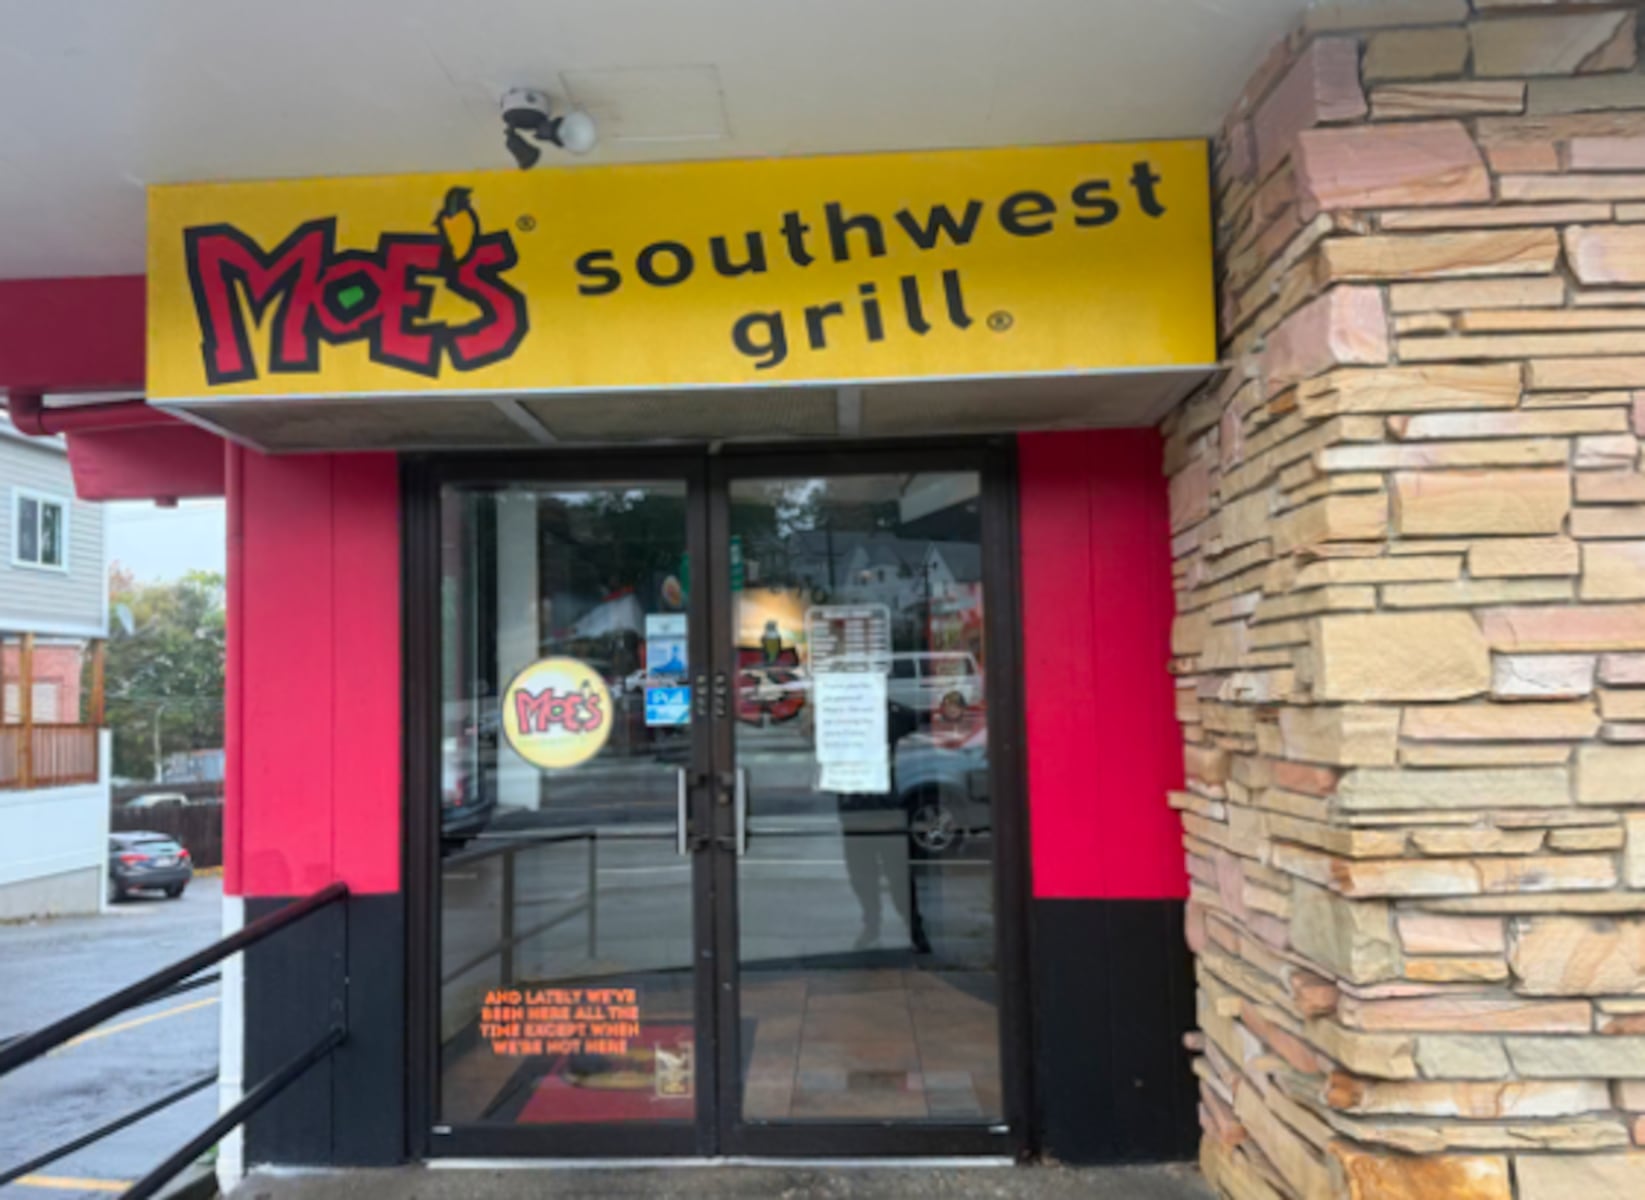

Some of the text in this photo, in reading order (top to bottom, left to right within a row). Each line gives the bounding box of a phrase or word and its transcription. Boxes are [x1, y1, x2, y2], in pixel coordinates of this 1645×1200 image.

[574, 161, 1167, 296] southwest
[731, 269, 974, 370] grill
[485, 990, 522, 1005] AND
[525, 989, 581, 1005] LATELY
[575, 1006, 605, 1020] ALL
[608, 1005, 639, 1020] THE
[524, 1023, 587, 1037] EXCEPT
